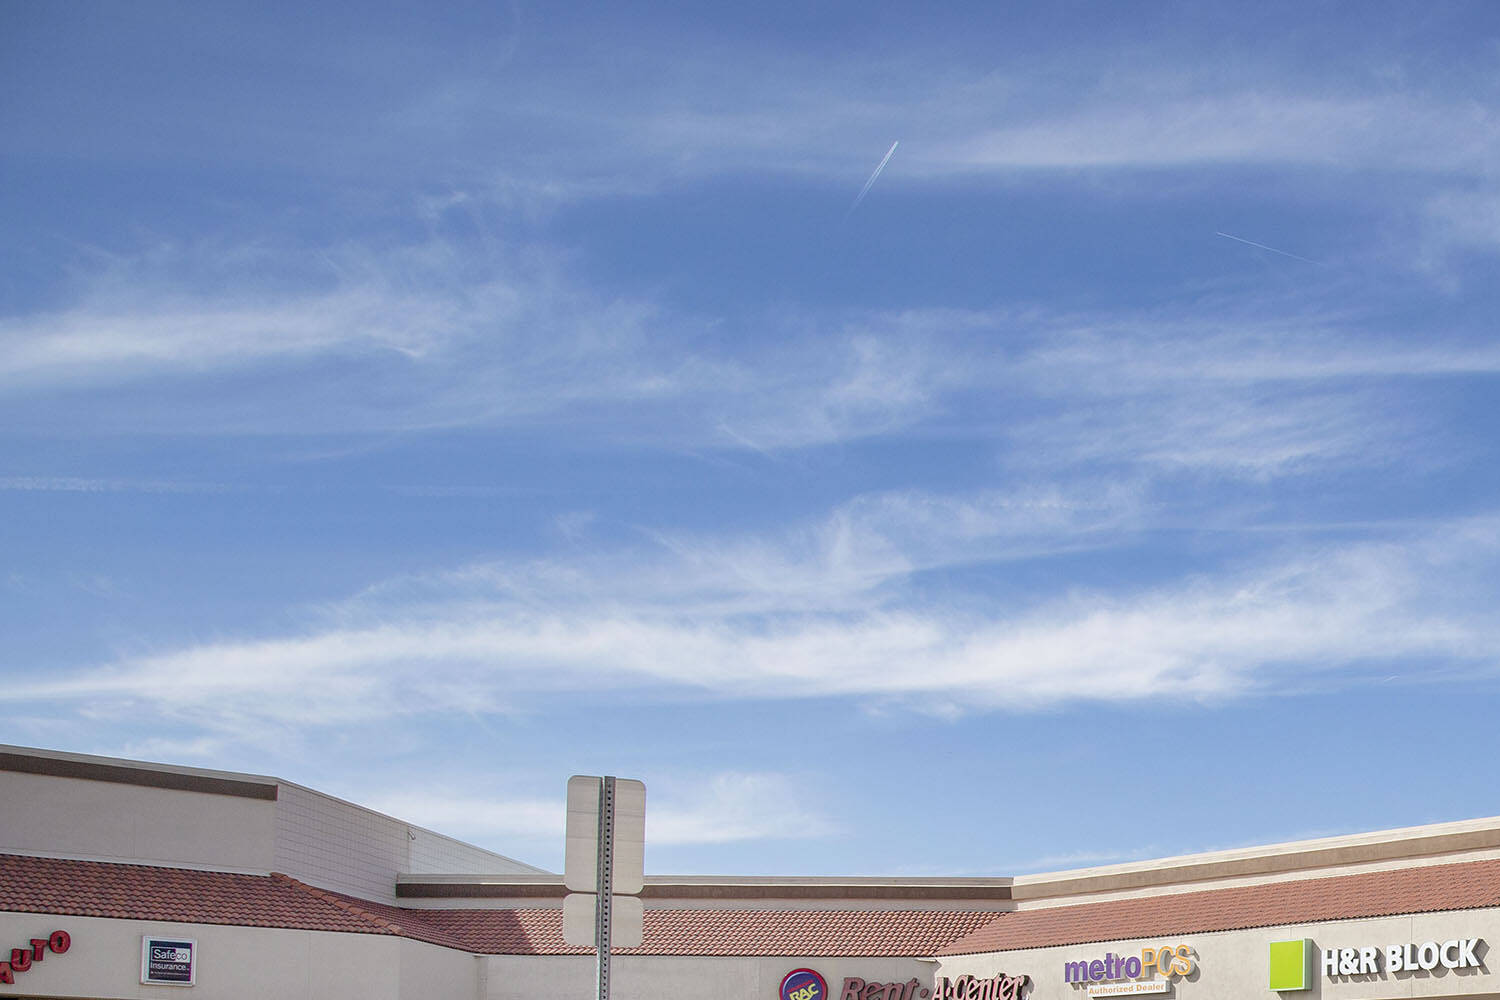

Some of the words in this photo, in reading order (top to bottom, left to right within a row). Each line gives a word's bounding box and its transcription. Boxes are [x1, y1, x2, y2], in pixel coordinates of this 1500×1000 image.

[0, 930, 71, 984] AUTO
[151, 962, 186, 970] Insurance
[154, 949, 188, 960] Safeco
[1064, 944, 1192, 983] metroPCS
[1321, 946, 1378, 976] H&R
[1385, 937, 1481, 973] BLOCK
[1088, 985, 1134, 995] Authorized
[1136, 983, 1165, 991] Dealer
